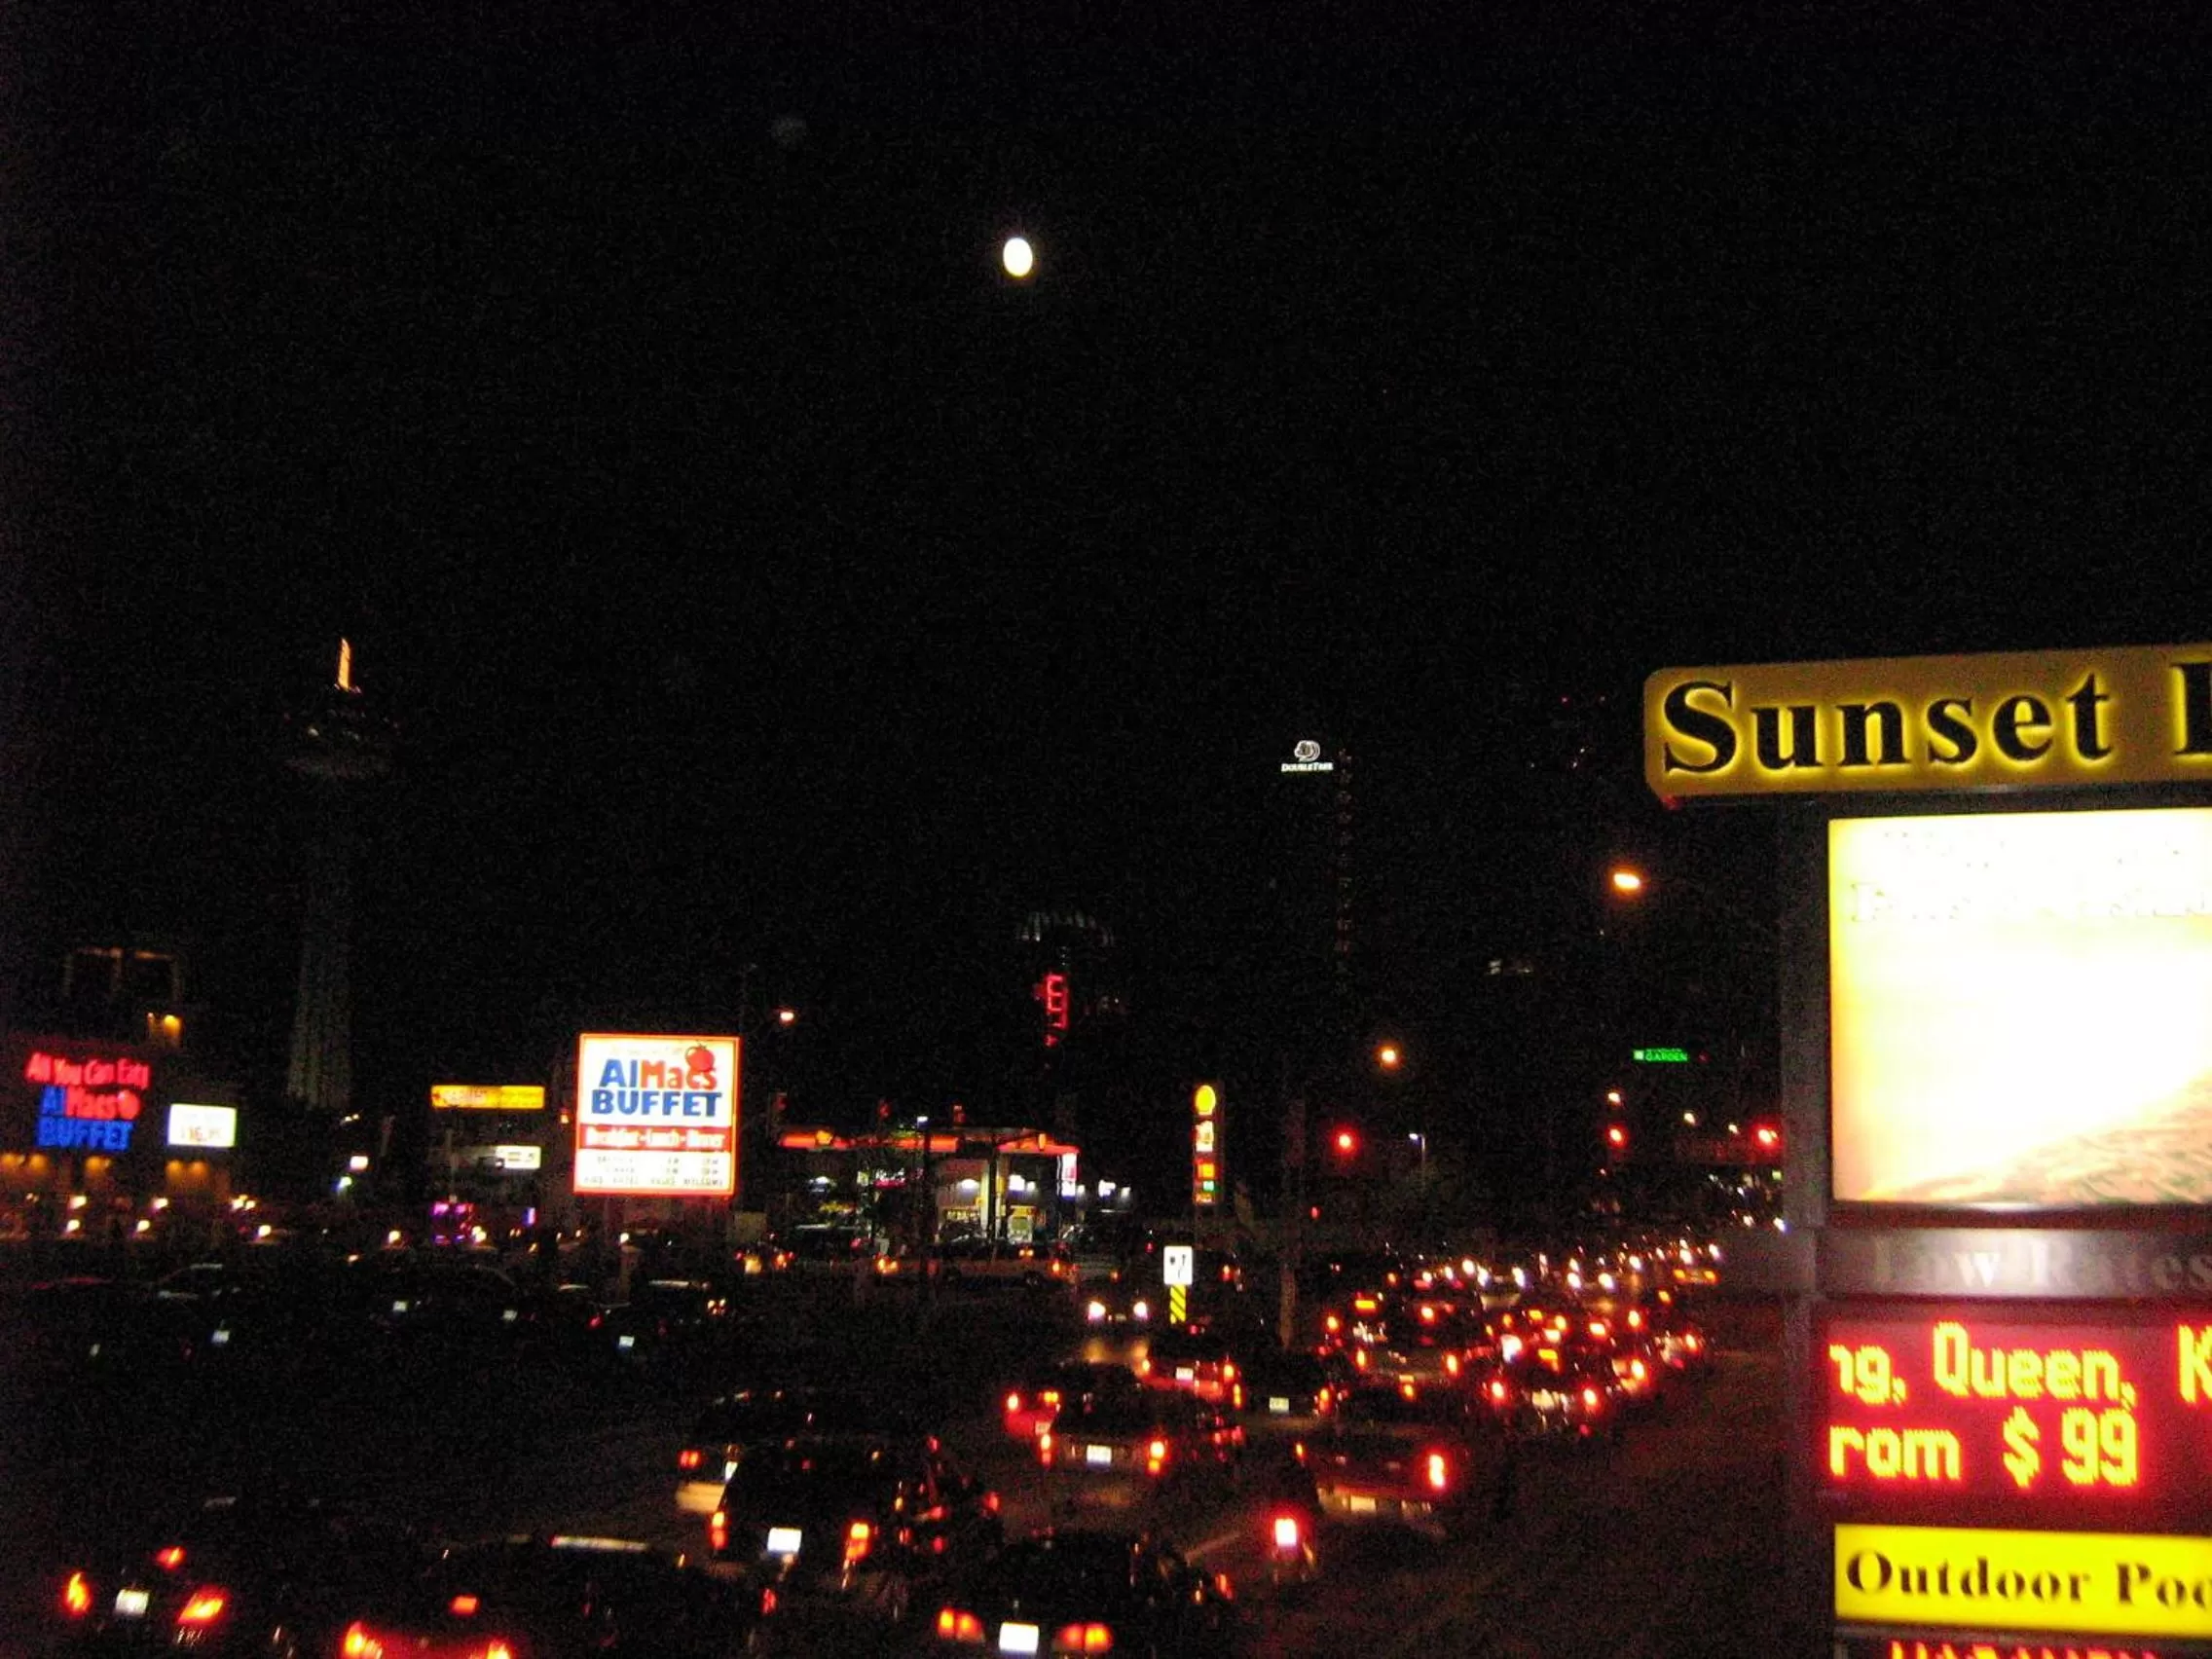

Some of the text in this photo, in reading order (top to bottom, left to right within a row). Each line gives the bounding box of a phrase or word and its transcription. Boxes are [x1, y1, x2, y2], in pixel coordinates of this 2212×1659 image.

[1663, 673, 2112, 774] Sunset
[591, 1088, 721, 1118] BUFFET
[37, 1117, 134, 1152] BUFFET
[1933, 1322, 2137, 1412] Queen,
[1829, 1425, 1961, 1480] rom
[1846, 1549, 2091, 1604] Outdoor
